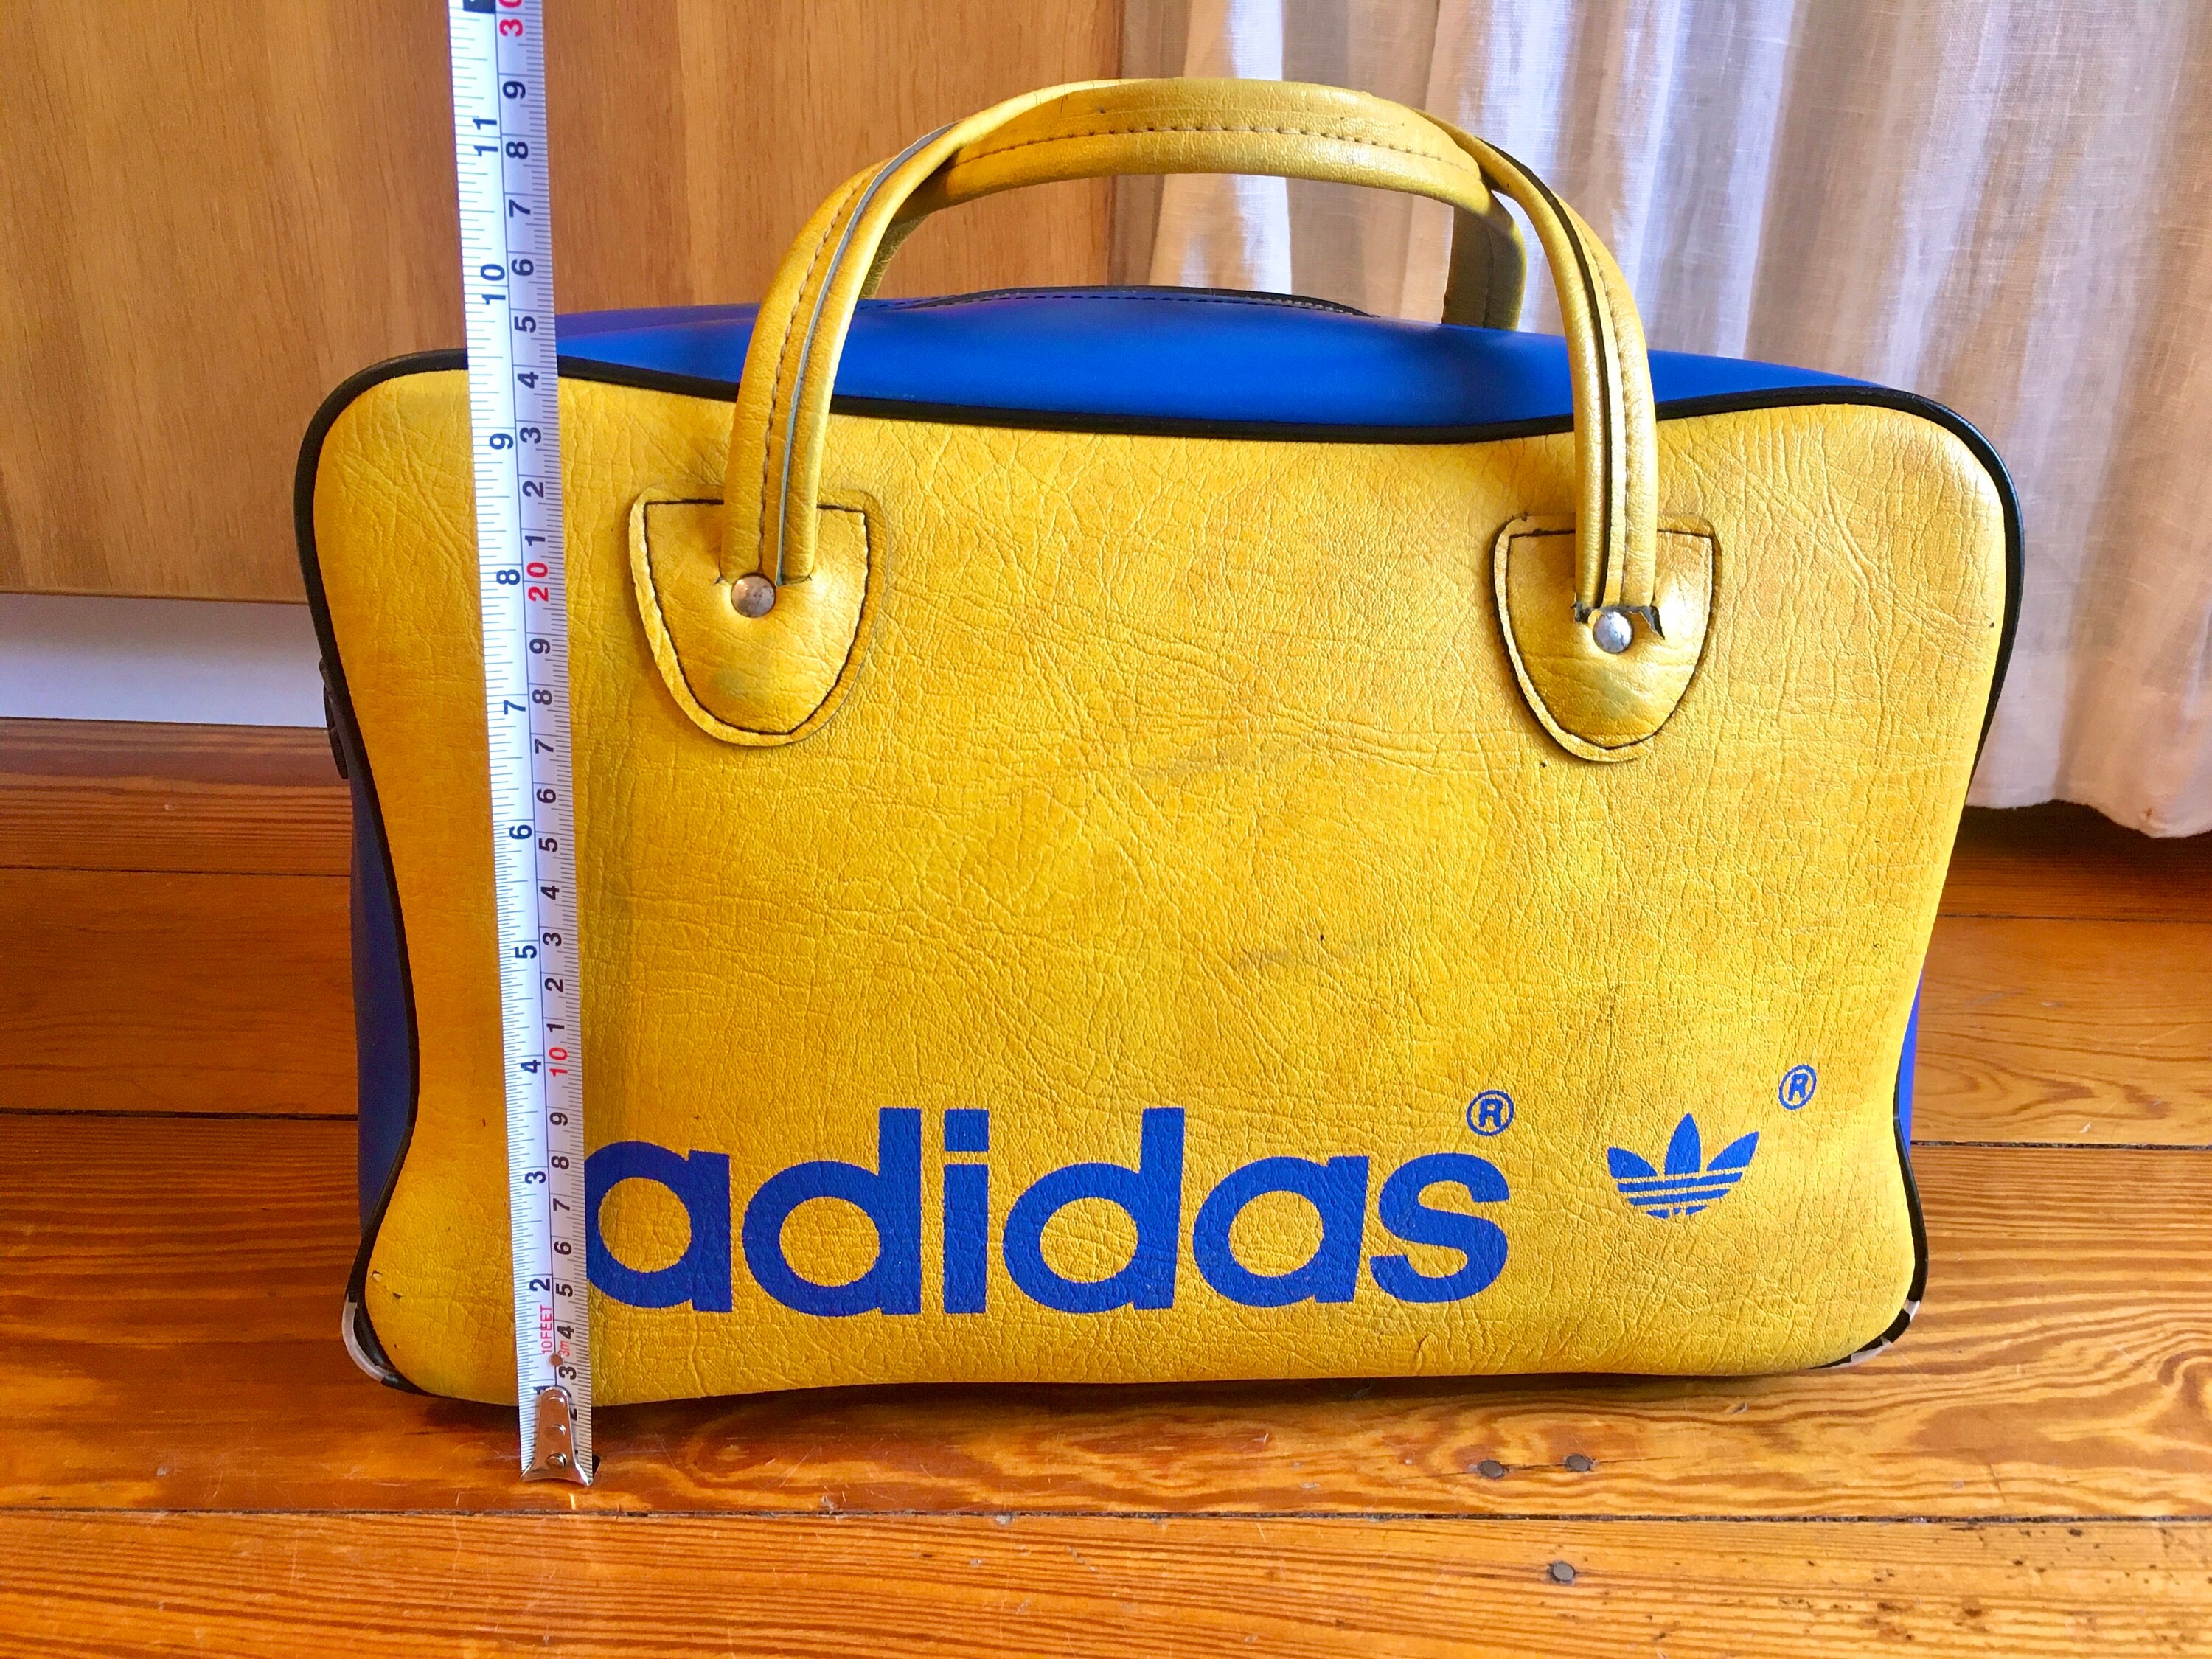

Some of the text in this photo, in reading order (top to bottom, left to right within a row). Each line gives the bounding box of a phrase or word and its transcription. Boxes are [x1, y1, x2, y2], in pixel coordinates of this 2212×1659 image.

[502, 81, 526, 99] 9
[473, 119, 498, 156] 11
[506, 142, 528, 159] 8
[509, 199, 531, 217] 7
[512, 259, 534, 276] 6
[480, 264, 506, 305] 10
[514, 316, 536, 333] 5
[518, 372, 538, 389] 4
[490, 433, 513, 449] 9
[520, 427, 541, 443] 3
[522, 481, 544, 498] 2
[525, 535, 545, 546] 1
[496, 569, 520, 585] 8
[526, 562, 549, 602] 20
[529, 639, 550, 654] 9
[532, 689, 552, 705] 8
[504, 700, 526, 714] 7
[535, 739, 554, 754] 7
[536, 788, 556, 804] 6
[509, 824, 532, 839] 6
[538, 838, 558, 852] 5
[540, 886, 560, 900] 4
[543, 932, 562, 946] 3
[515, 945, 537, 959] 5
[545, 978, 563, 992] 2
[546, 1023, 565, 1032] 1
[521, 1060, 542, 1074] 4
[549, 1047, 568, 1077] 10
[549, 1112, 568, 1126] 9
[551, 1156, 569, 1169] 8
[525, 1171, 546, 1184] 3
[553, 1198, 570, 1211] 7
[585, 1107, 1510, 1317] adidas
[554, 1241, 572, 1255] 6
[529, 1278, 550, 1292] 2
[555, 1283, 574, 1298] 5
[557, 1325, 574, 1340] 4
[558, 1366, 577, 1380] 3
